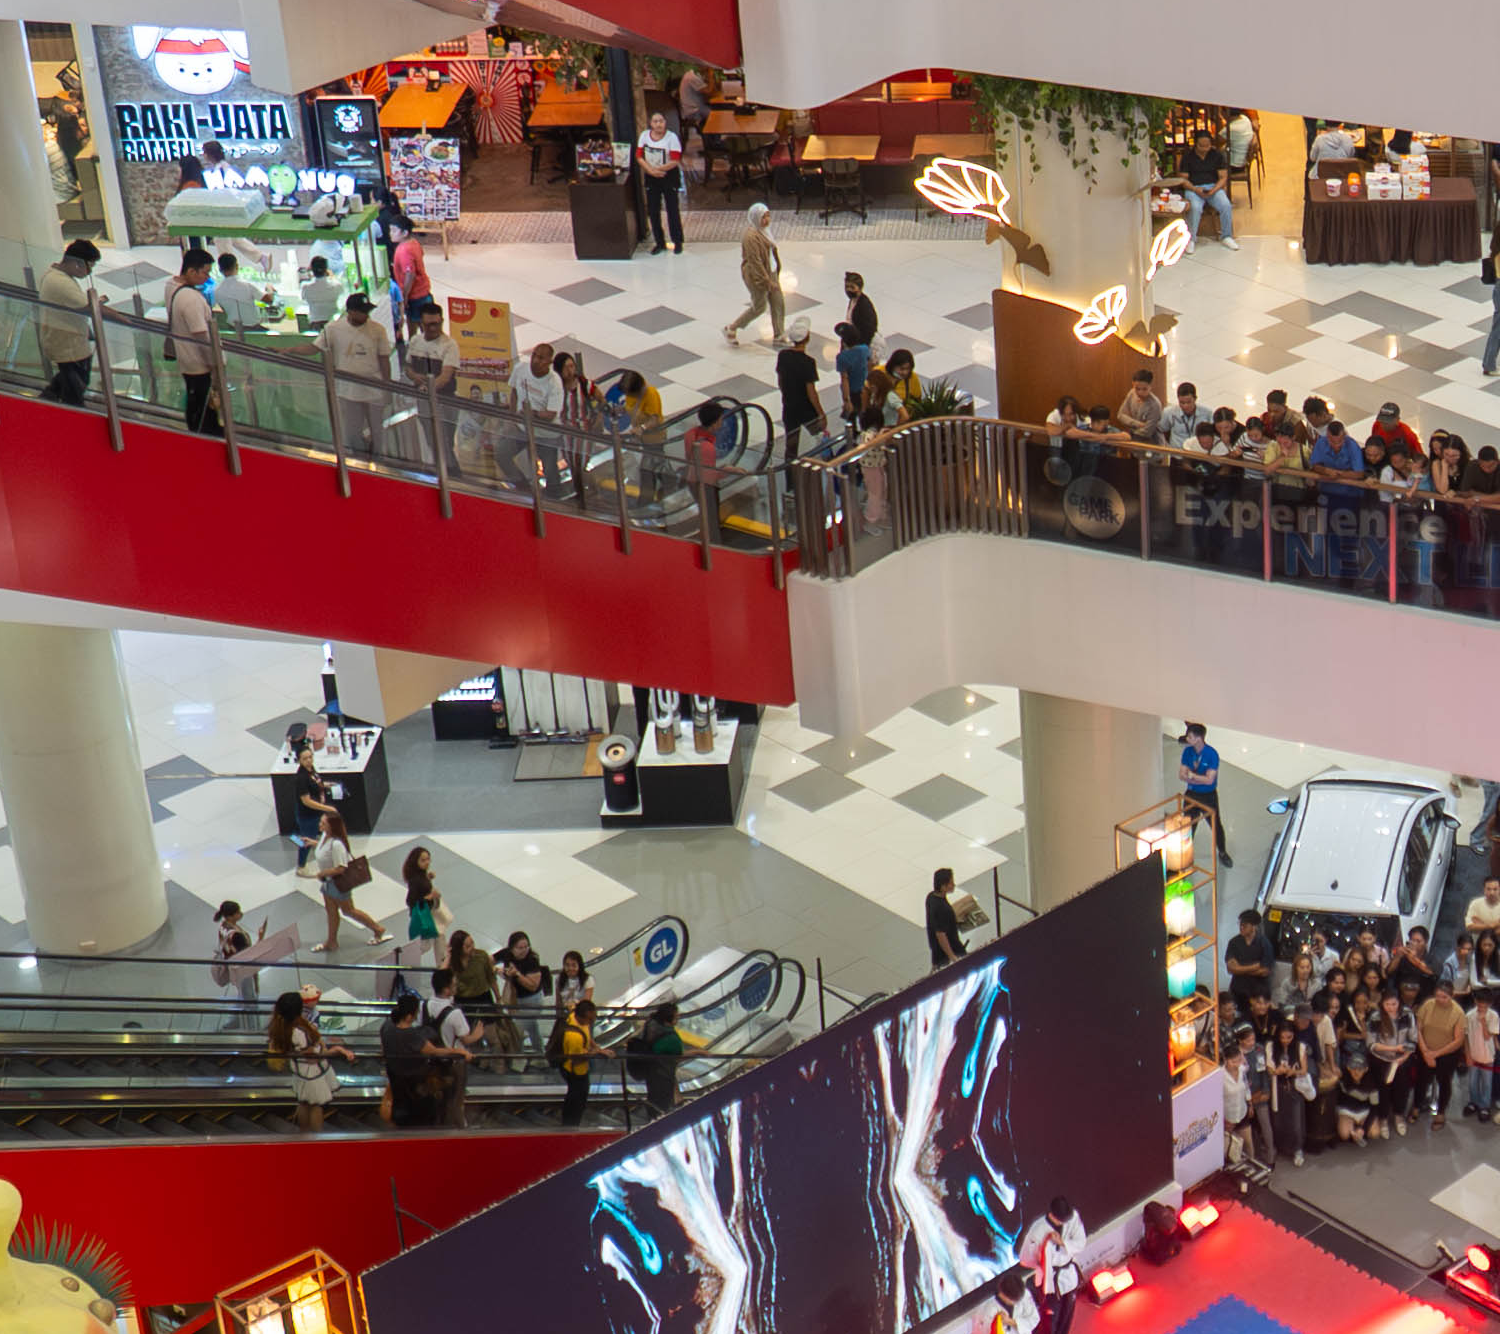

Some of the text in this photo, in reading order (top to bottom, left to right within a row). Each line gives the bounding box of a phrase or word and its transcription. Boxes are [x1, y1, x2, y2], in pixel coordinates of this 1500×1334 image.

[116, 102, 294, 139] RAKI-YATA
[1174, 484, 1447, 544] Experience
[1284, 530, 1445, 587] NEXT
[649, 938, 674, 964] GL
